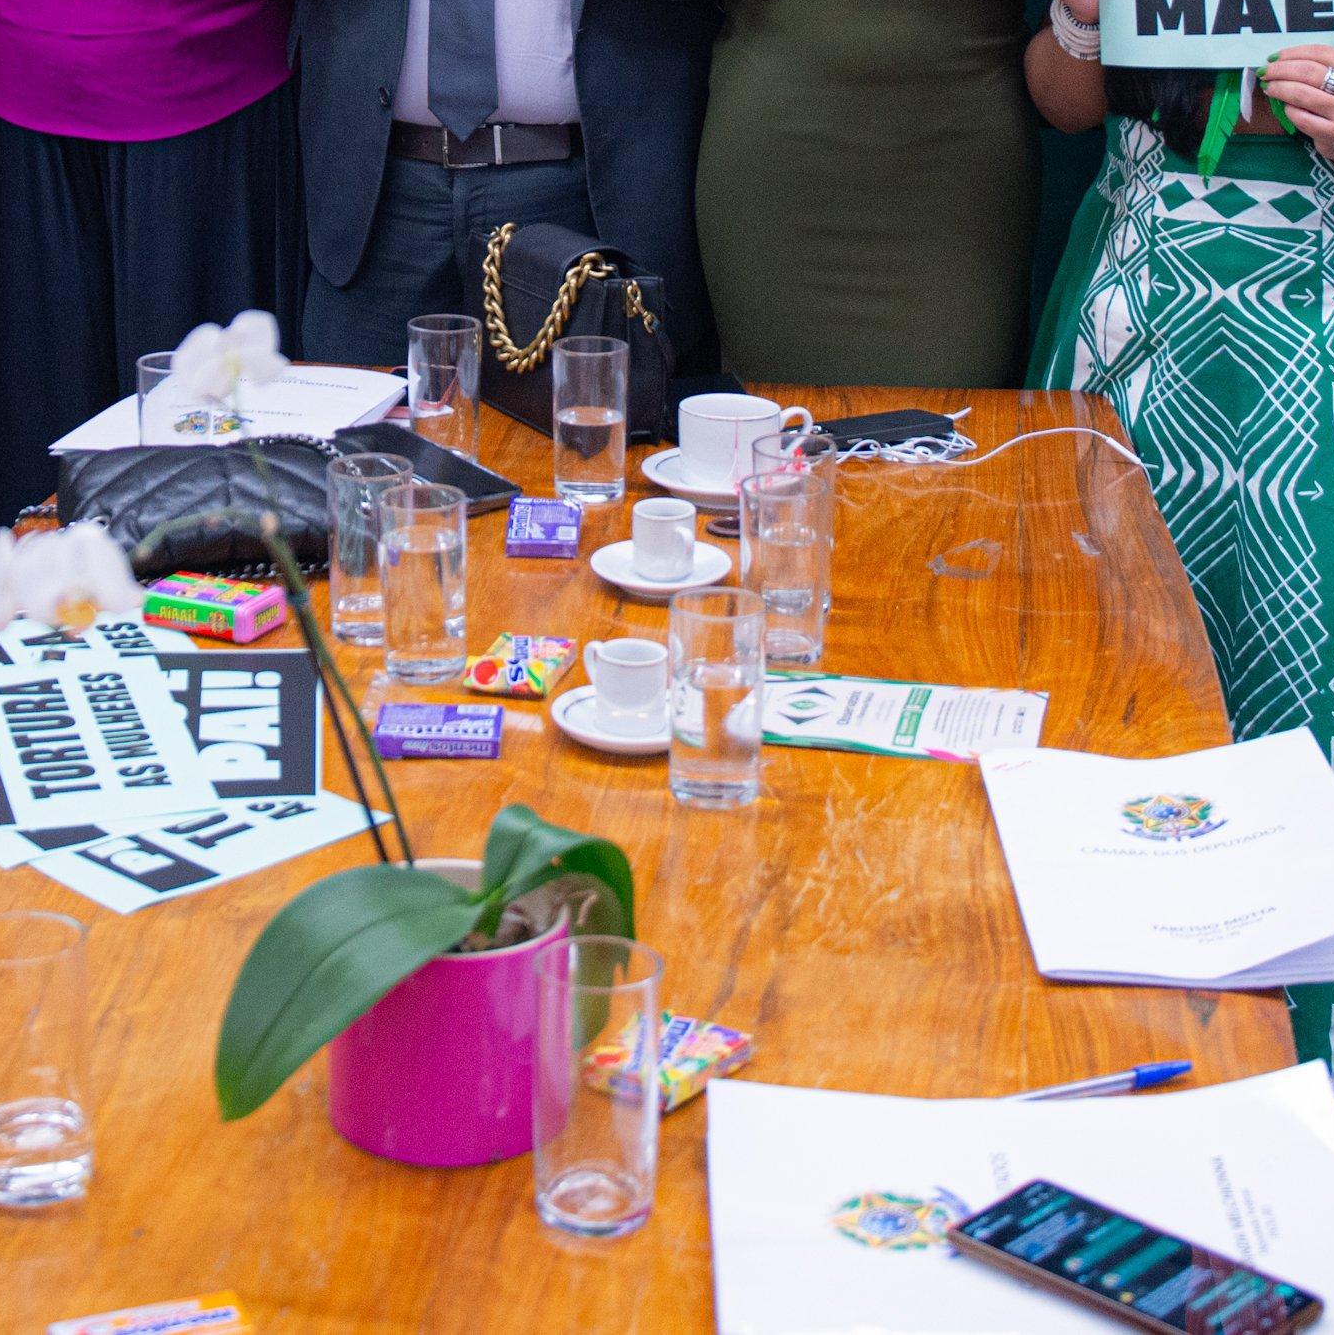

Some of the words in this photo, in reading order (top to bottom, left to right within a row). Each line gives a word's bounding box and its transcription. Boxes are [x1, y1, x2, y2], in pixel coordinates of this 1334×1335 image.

[79, 671, 157, 760] MULHERES
[198, 670, 282, 780] PAI!
[118, 764, 171, 788] AS
